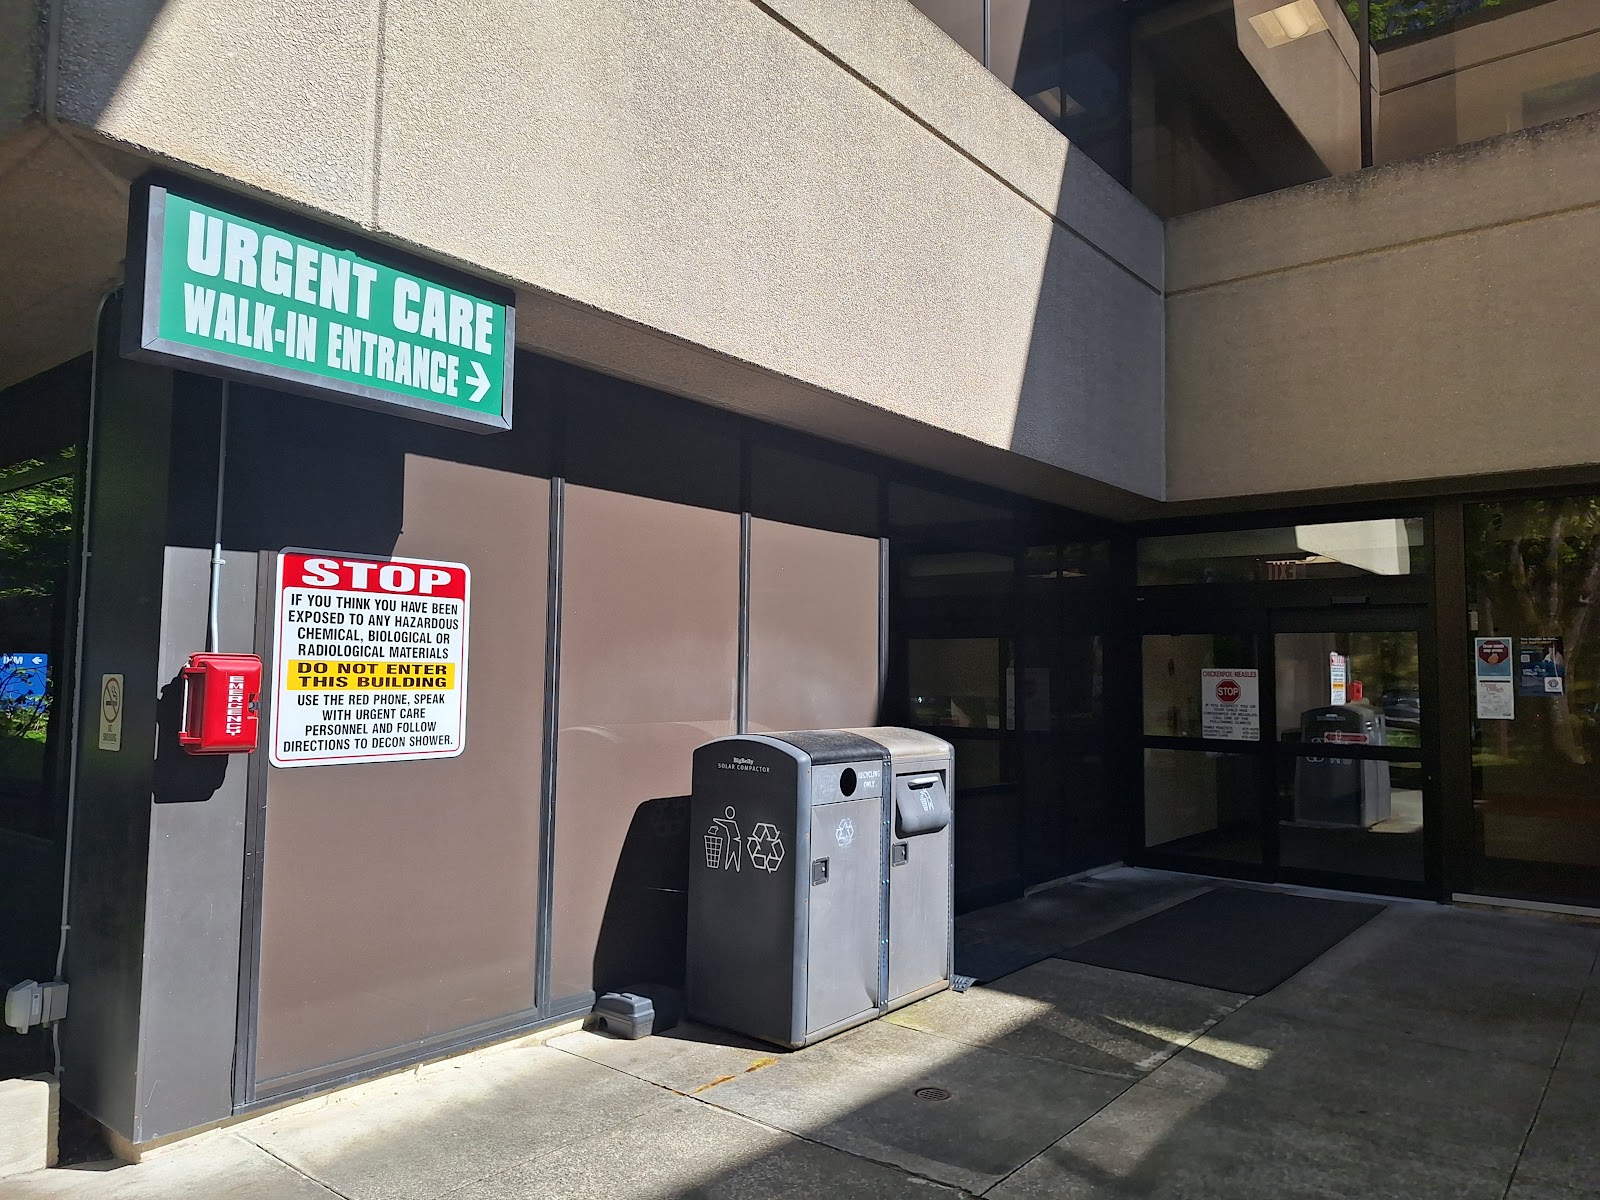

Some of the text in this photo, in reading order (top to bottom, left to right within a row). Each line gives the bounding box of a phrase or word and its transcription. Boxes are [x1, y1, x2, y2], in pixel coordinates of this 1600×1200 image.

[186, 210, 494, 356] URGENT CARE
[184, 283, 459, 397] WALK-IN ENTRANCE
[302, 558, 451, 594] STOP
[291, 594, 458, 615] IF YOU THINK YOU HAVE BEEN
[288, 610, 458, 630] EXPOSED TO ANY HAZARDOUS
[298, 627, 450, 644] CHEMICAL, BIOLOGICAL OR
[298, 644, 448, 659] RADIOLOGICAL MATERIALS
[298, 662, 446, 674] DO NOT ENTER
[299, 676, 446, 688] THIS BUILDING
[1218, 687, 1238, 696] STOP
[226, 676, 244, 736] EMERGENCY
[298, 694, 445, 706] USE THE RED PHONE, SPEAK
[322, 708, 426, 720] WITH URGENT CARE
[305, 722, 436, 736] PERSONNEL AND FOLLOW
[284, 734, 453, 752] DIRECTIONS TO DECON SHOWER.
[858, 770, 881, 779] RECYCLING
